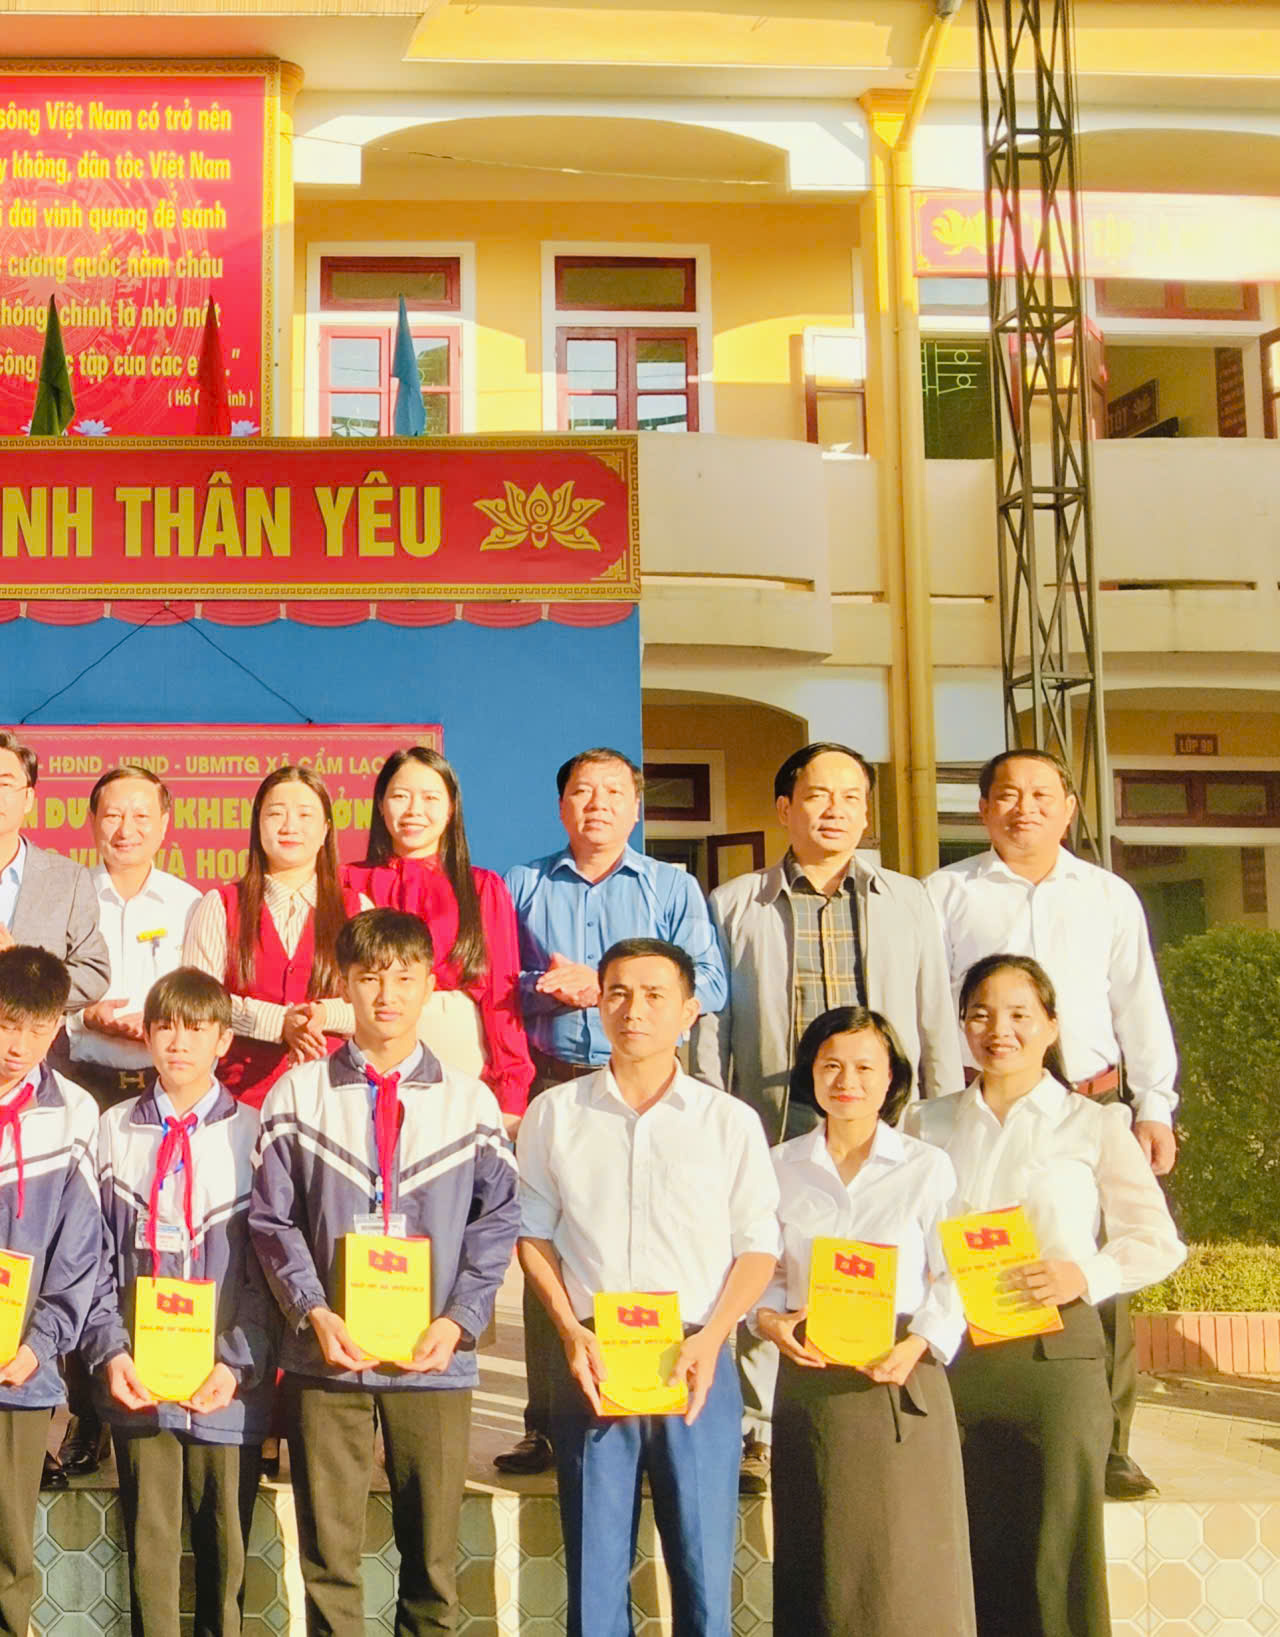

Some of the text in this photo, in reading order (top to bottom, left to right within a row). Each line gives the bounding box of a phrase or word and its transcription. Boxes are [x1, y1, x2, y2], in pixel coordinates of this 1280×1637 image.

[46, 101, 83, 139] Việt
[89, 101, 132, 131] Nam
[137, 101, 160, 131] có
[165, 97, 192, 131] trở
[198, 101, 232, 131] nên
[12, 149, 72, 185] không,
[77, 150, 110, 180] dân
[115, 151, 144, 189] tộc
[149, 151, 185, 189] Việt
[190, 151, 231, 180] Nam
[8, 197, 37, 228] đài
[44, 199, 82, 228] vinh
[88, 207, 147, 236] quang
[153, 190, 176, 229] để
[182, 200, 226, 229] sánh
[7, 247, 67, 284] cường
[74, 243, 120, 284] quốc
[175, 249, 223, 279] châu
[60, 299, 111, 327] chính
[118, 299, 136, 327] là
[141, 298, 177, 327] nhờ
[79, 347, 108, 384] tập
[114, 345, 146, 376] của
[151, 347, 182, 376] các
[226, 390, 246, 406] inh
[115, 471, 291, 558] THÂN
[314, 470, 442, 558] YÊU
[49, 755, 102, 775] HĐND
[185, 755, 260, 775] UBMTTQ
